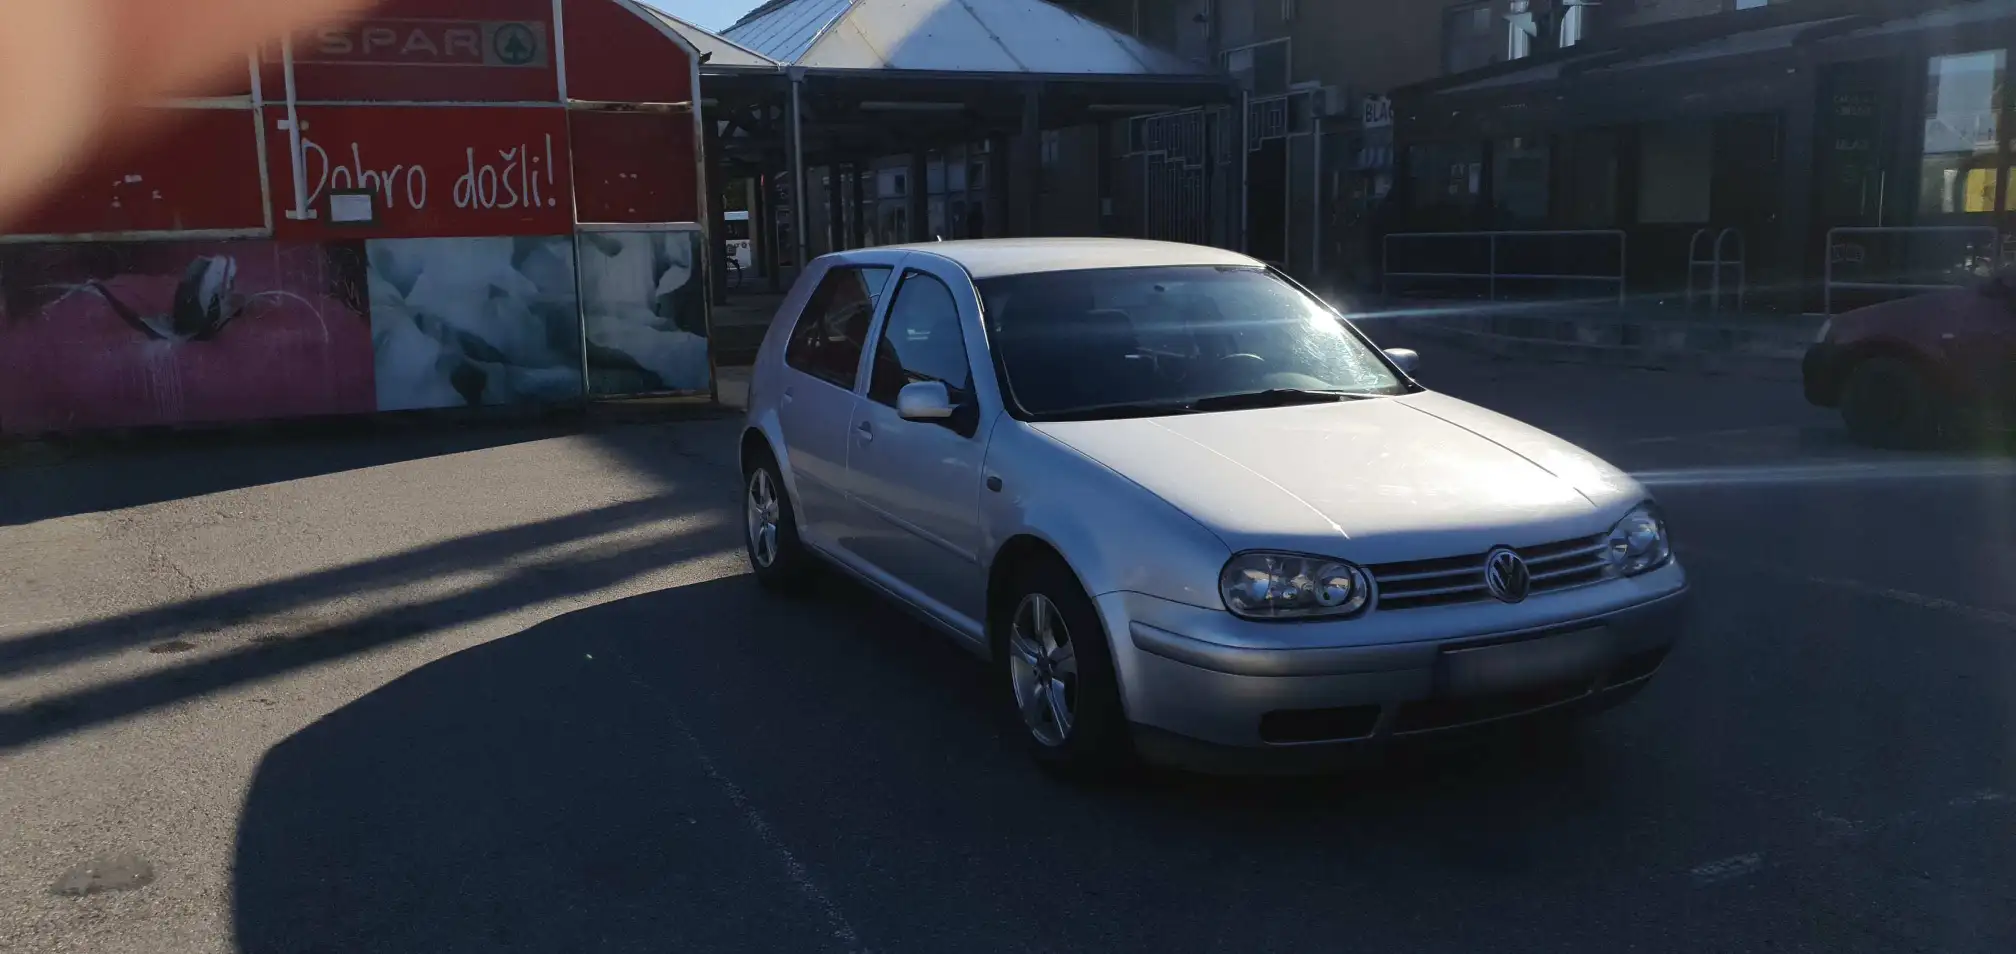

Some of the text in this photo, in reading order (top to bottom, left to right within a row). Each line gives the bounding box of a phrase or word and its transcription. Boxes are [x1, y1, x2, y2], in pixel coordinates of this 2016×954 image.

[315, 27, 479, 57] SPAR
[300, 131, 557, 210] Dobro došli!
